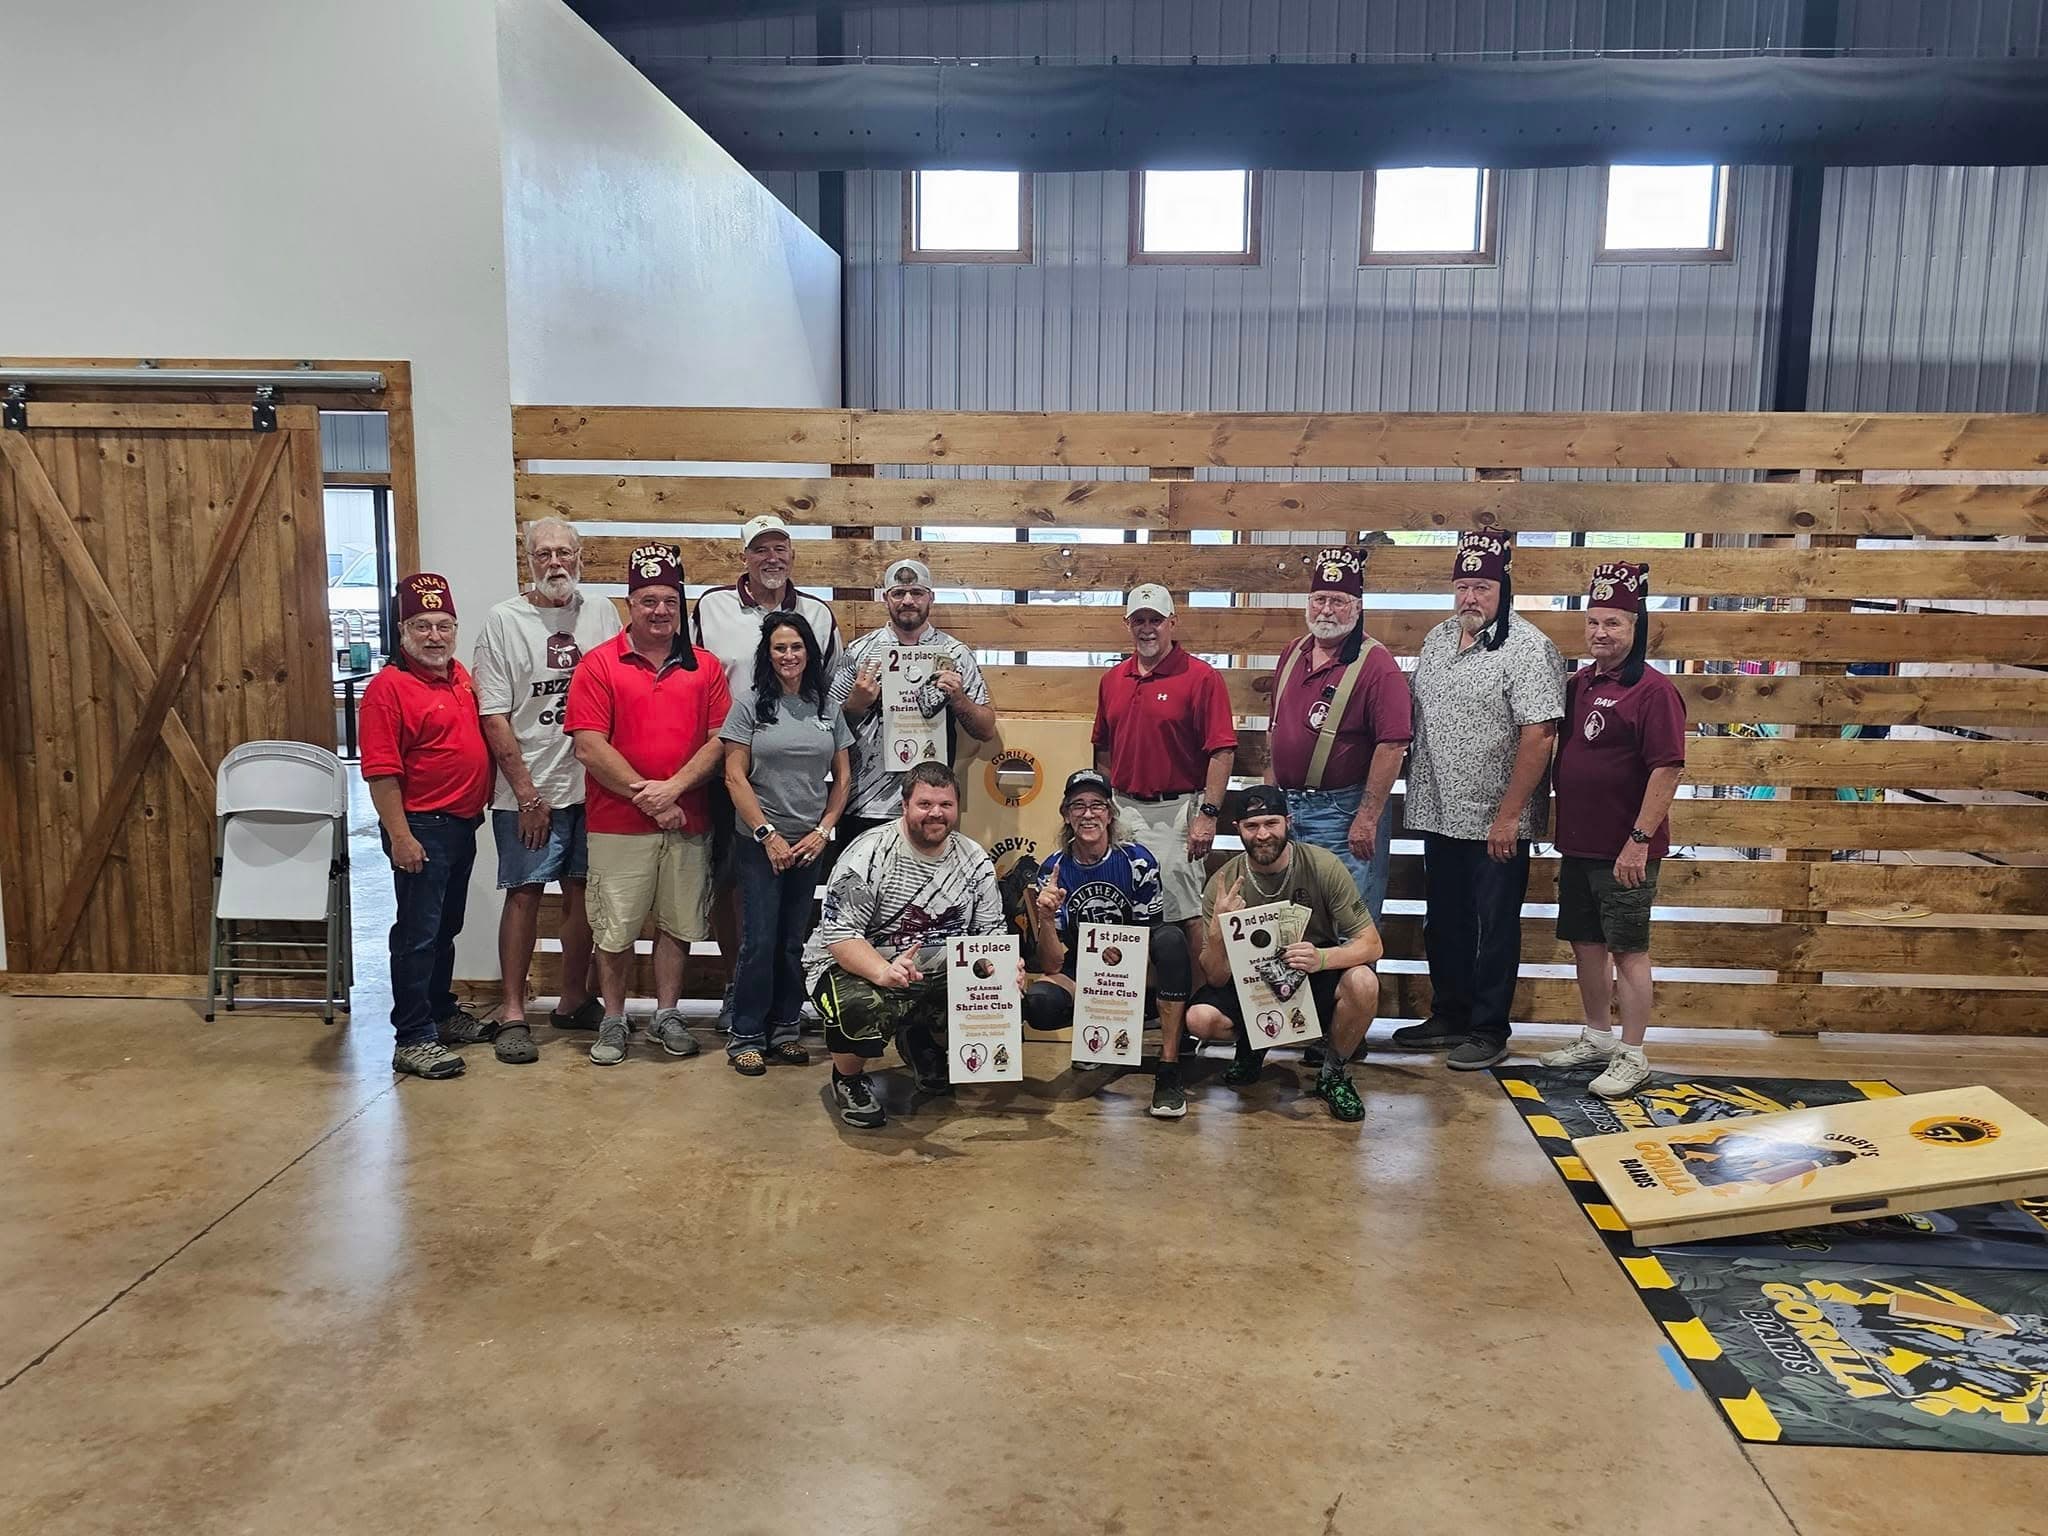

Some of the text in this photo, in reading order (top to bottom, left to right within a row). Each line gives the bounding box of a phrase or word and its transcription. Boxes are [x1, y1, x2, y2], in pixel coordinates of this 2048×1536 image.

[411, 576, 447, 591] AINAD
[991, 750, 1036, 766] GORILLA
[1005, 798, 1021, 807] PIT
[1068, 885, 1127, 914] SOUTHERN
[1258, 911, 1280, 925] plac
[1112, 932, 1141, 943] place
[981, 942, 1011, 954] place
[1096, 978, 1125, 987] Salem
[969, 993, 999, 1001] Salem
[1082, 987, 1138, 998] Shrine Club
[955, 1002, 1013, 1012] Shrine Club
[1823, 1133, 1880, 1157] GIBBY'S
[1619, 1159, 1658, 1189] BOARDS
[1635, 1141, 1697, 1197] GORILLA
[1740, 1309, 1820, 1376] BOARDS
[1761, 1282, 1892, 1398] GORILLA
